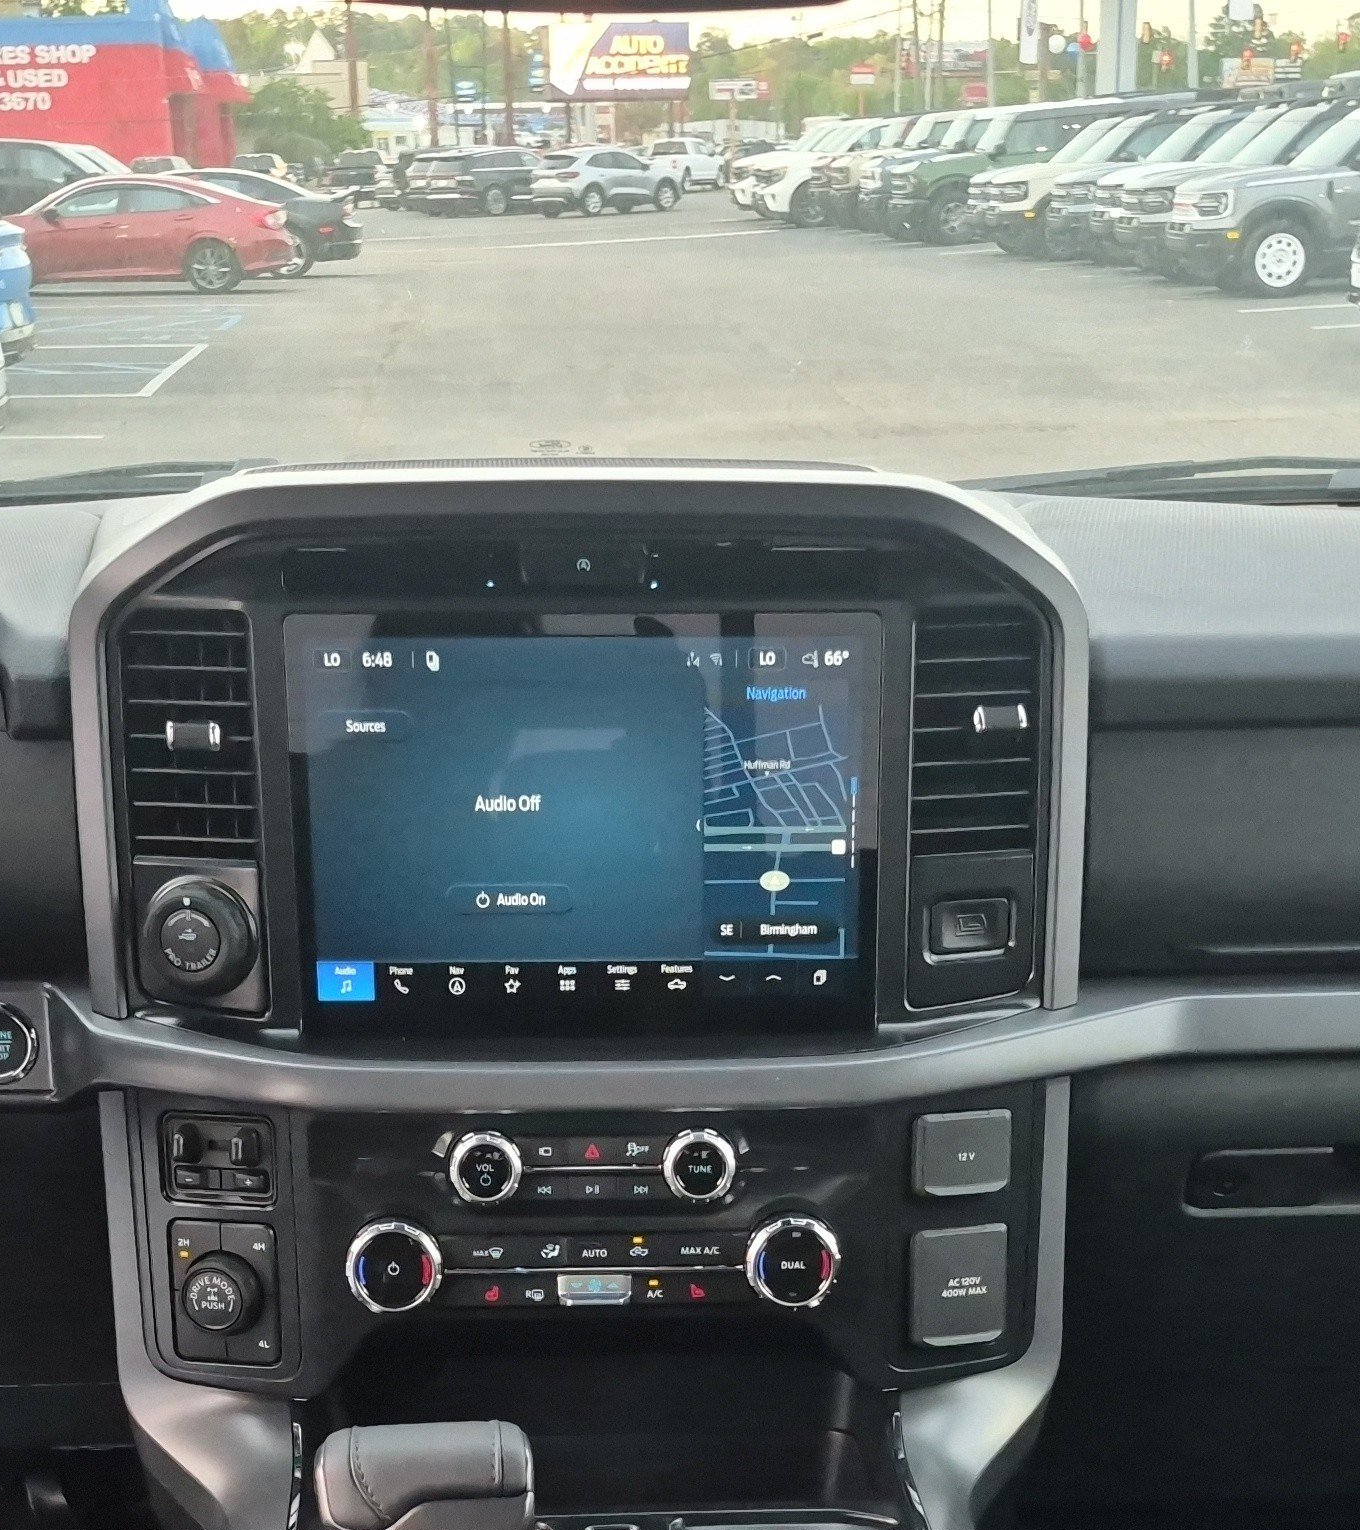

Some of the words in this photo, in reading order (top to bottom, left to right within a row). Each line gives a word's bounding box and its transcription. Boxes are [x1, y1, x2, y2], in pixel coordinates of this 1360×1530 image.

[609, 35, 665, 55] AUTO
[35, 44, 97, 64] SHOP
[7, 68, 68, 88] USED
[323, 652, 341, 667] LO
[362, 651, 393, 668] 6:48
[759, 651, 776, 666] LO
[746, 686, 807, 702] Navigation
[345, 720, 386, 733] Sources
[475, 795, 516, 812] Audio
[518, 795, 541, 812] Off
[497, 893, 528, 906] Audio
[529, 893, 546, 906] On
[720, 923, 734, 936] SE
[760, 923, 818, 937] Birmingham
[163, 947, 182, 966] PRO
[185, 948, 218, 971] TRAILER
[334, 966, 357, 976] Audio
[389, 966, 414, 976] Phone
[449, 966, 465, 976] Nav
[505, 965, 520, 975] Fav
[557, 965, 577, 976] Apps
[606, 965, 638, 976] Settings
[660, 964, 694, 975] Features
[958, 1152, 967, 1161] 12
[476, 1164, 495, 1173] VOL
[688, 1165, 713, 1174] TUNE
[177, 1238, 190, 1247] 2H
[252, 1243, 266, 1251] 4H
[581, 1248, 608, 1258] AUTO
[681, 1247, 702, 1255] MAX
[703, 1246, 720, 1255] A/C
[780, 1261, 806, 1270] DUAL
[948, 1278, 960, 1287] AC
[960, 1276, 981, 1286] 120V
[190, 1276, 211, 1300] DRIVE
[212, 1276, 236, 1300] MODE
[941, 1288, 967, 1298] 400W
[968, 1286, 987, 1295] MAX
[646, 1289, 664, 1299] A/C
[201, 1301, 225, 1310] PUSH
[258, 1340, 270, 1349] 4L
